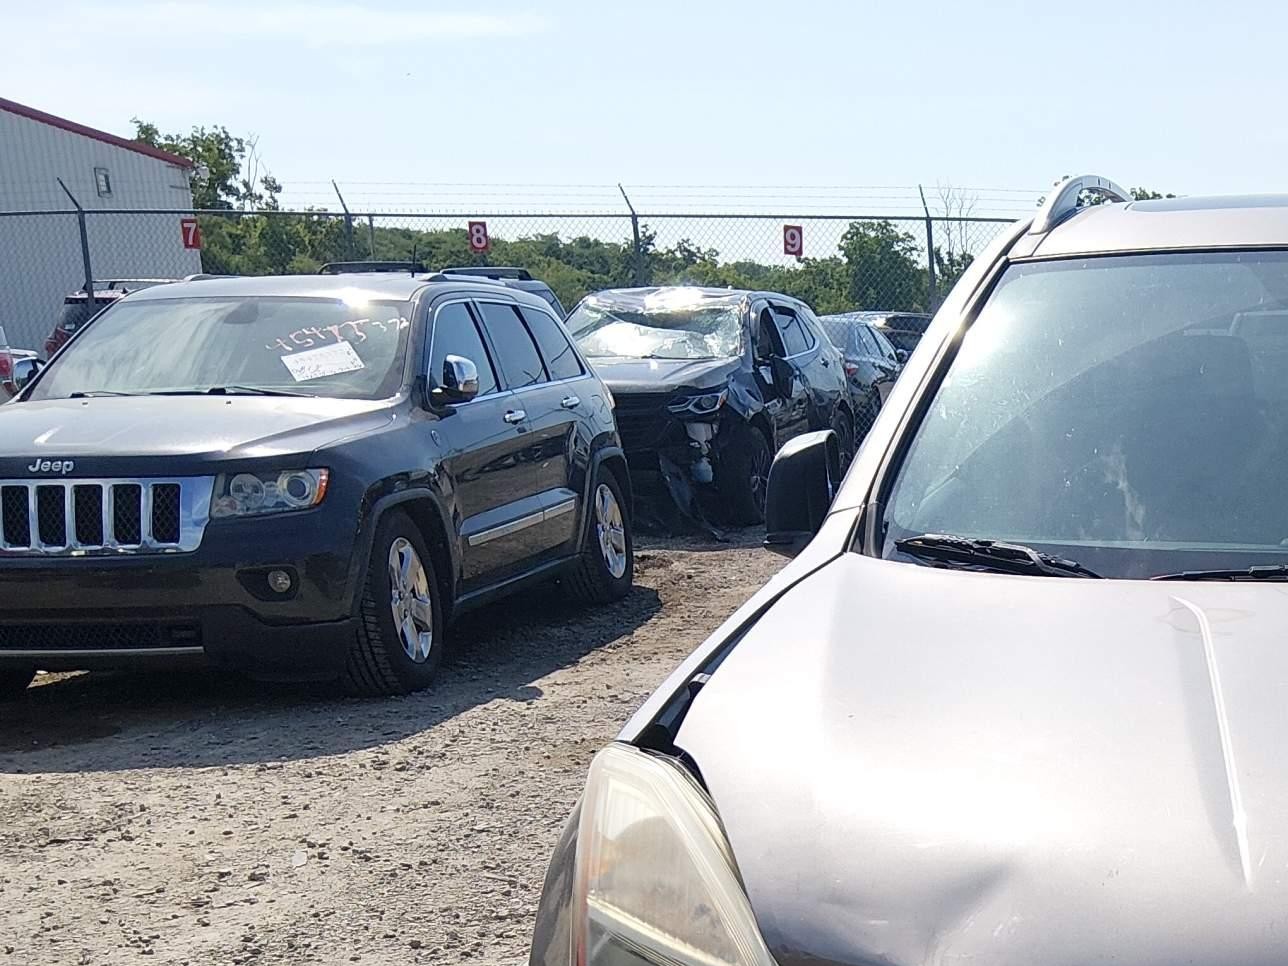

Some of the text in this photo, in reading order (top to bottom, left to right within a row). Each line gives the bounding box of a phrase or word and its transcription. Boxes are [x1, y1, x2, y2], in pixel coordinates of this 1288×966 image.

[183, 222, 197, 246] 7
[471, 224, 487, 248] 8
[785, 228, 801, 252] 9
[28, 458, 74, 475] Jeep
